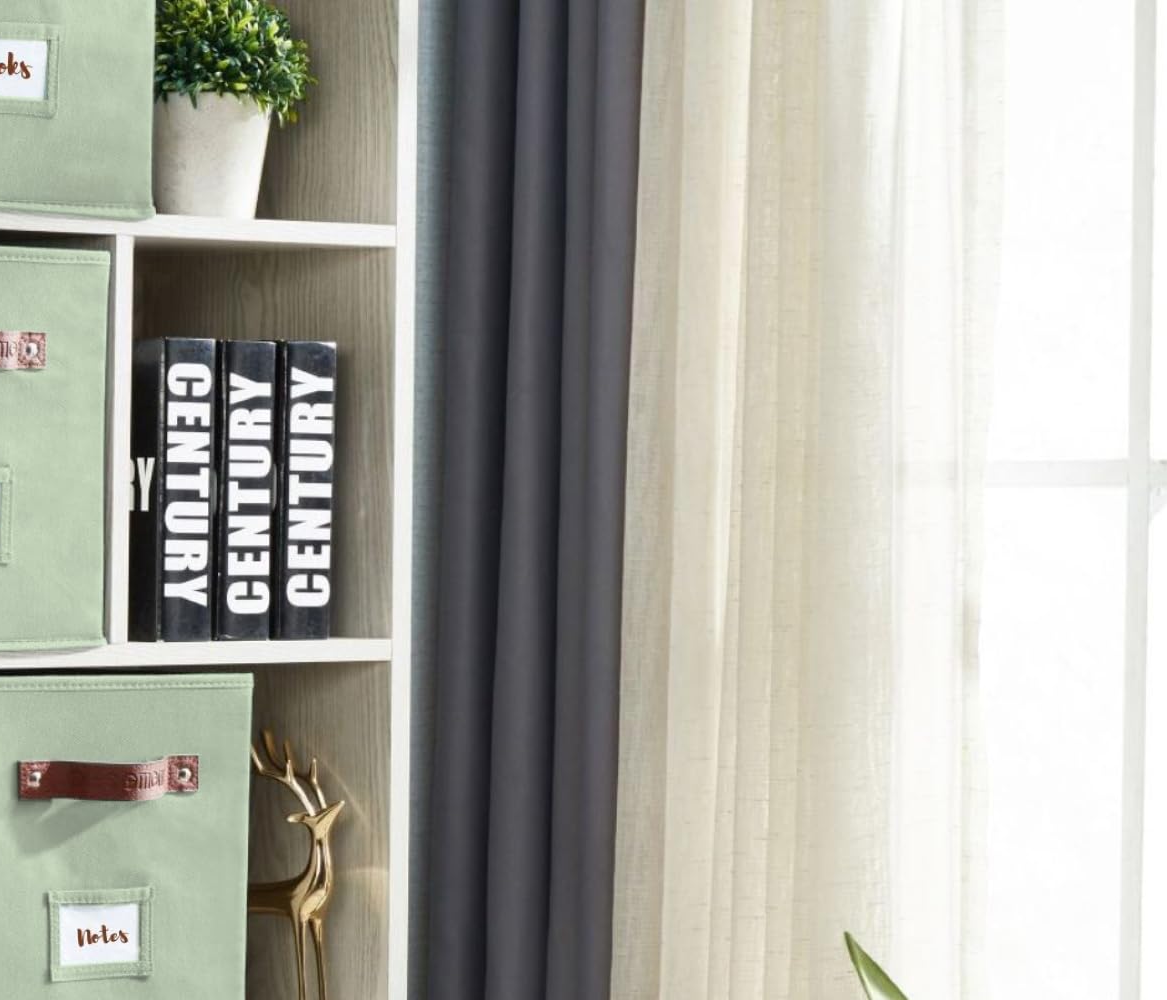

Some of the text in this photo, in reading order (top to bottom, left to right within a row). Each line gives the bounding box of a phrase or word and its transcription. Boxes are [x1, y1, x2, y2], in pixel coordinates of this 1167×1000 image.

[164, 363, 212, 608] CENTURY
[227, 372, 272, 614] CENTURY
[286, 367, 335, 608] CENTURY
[77, 925, 129, 947] Notes
